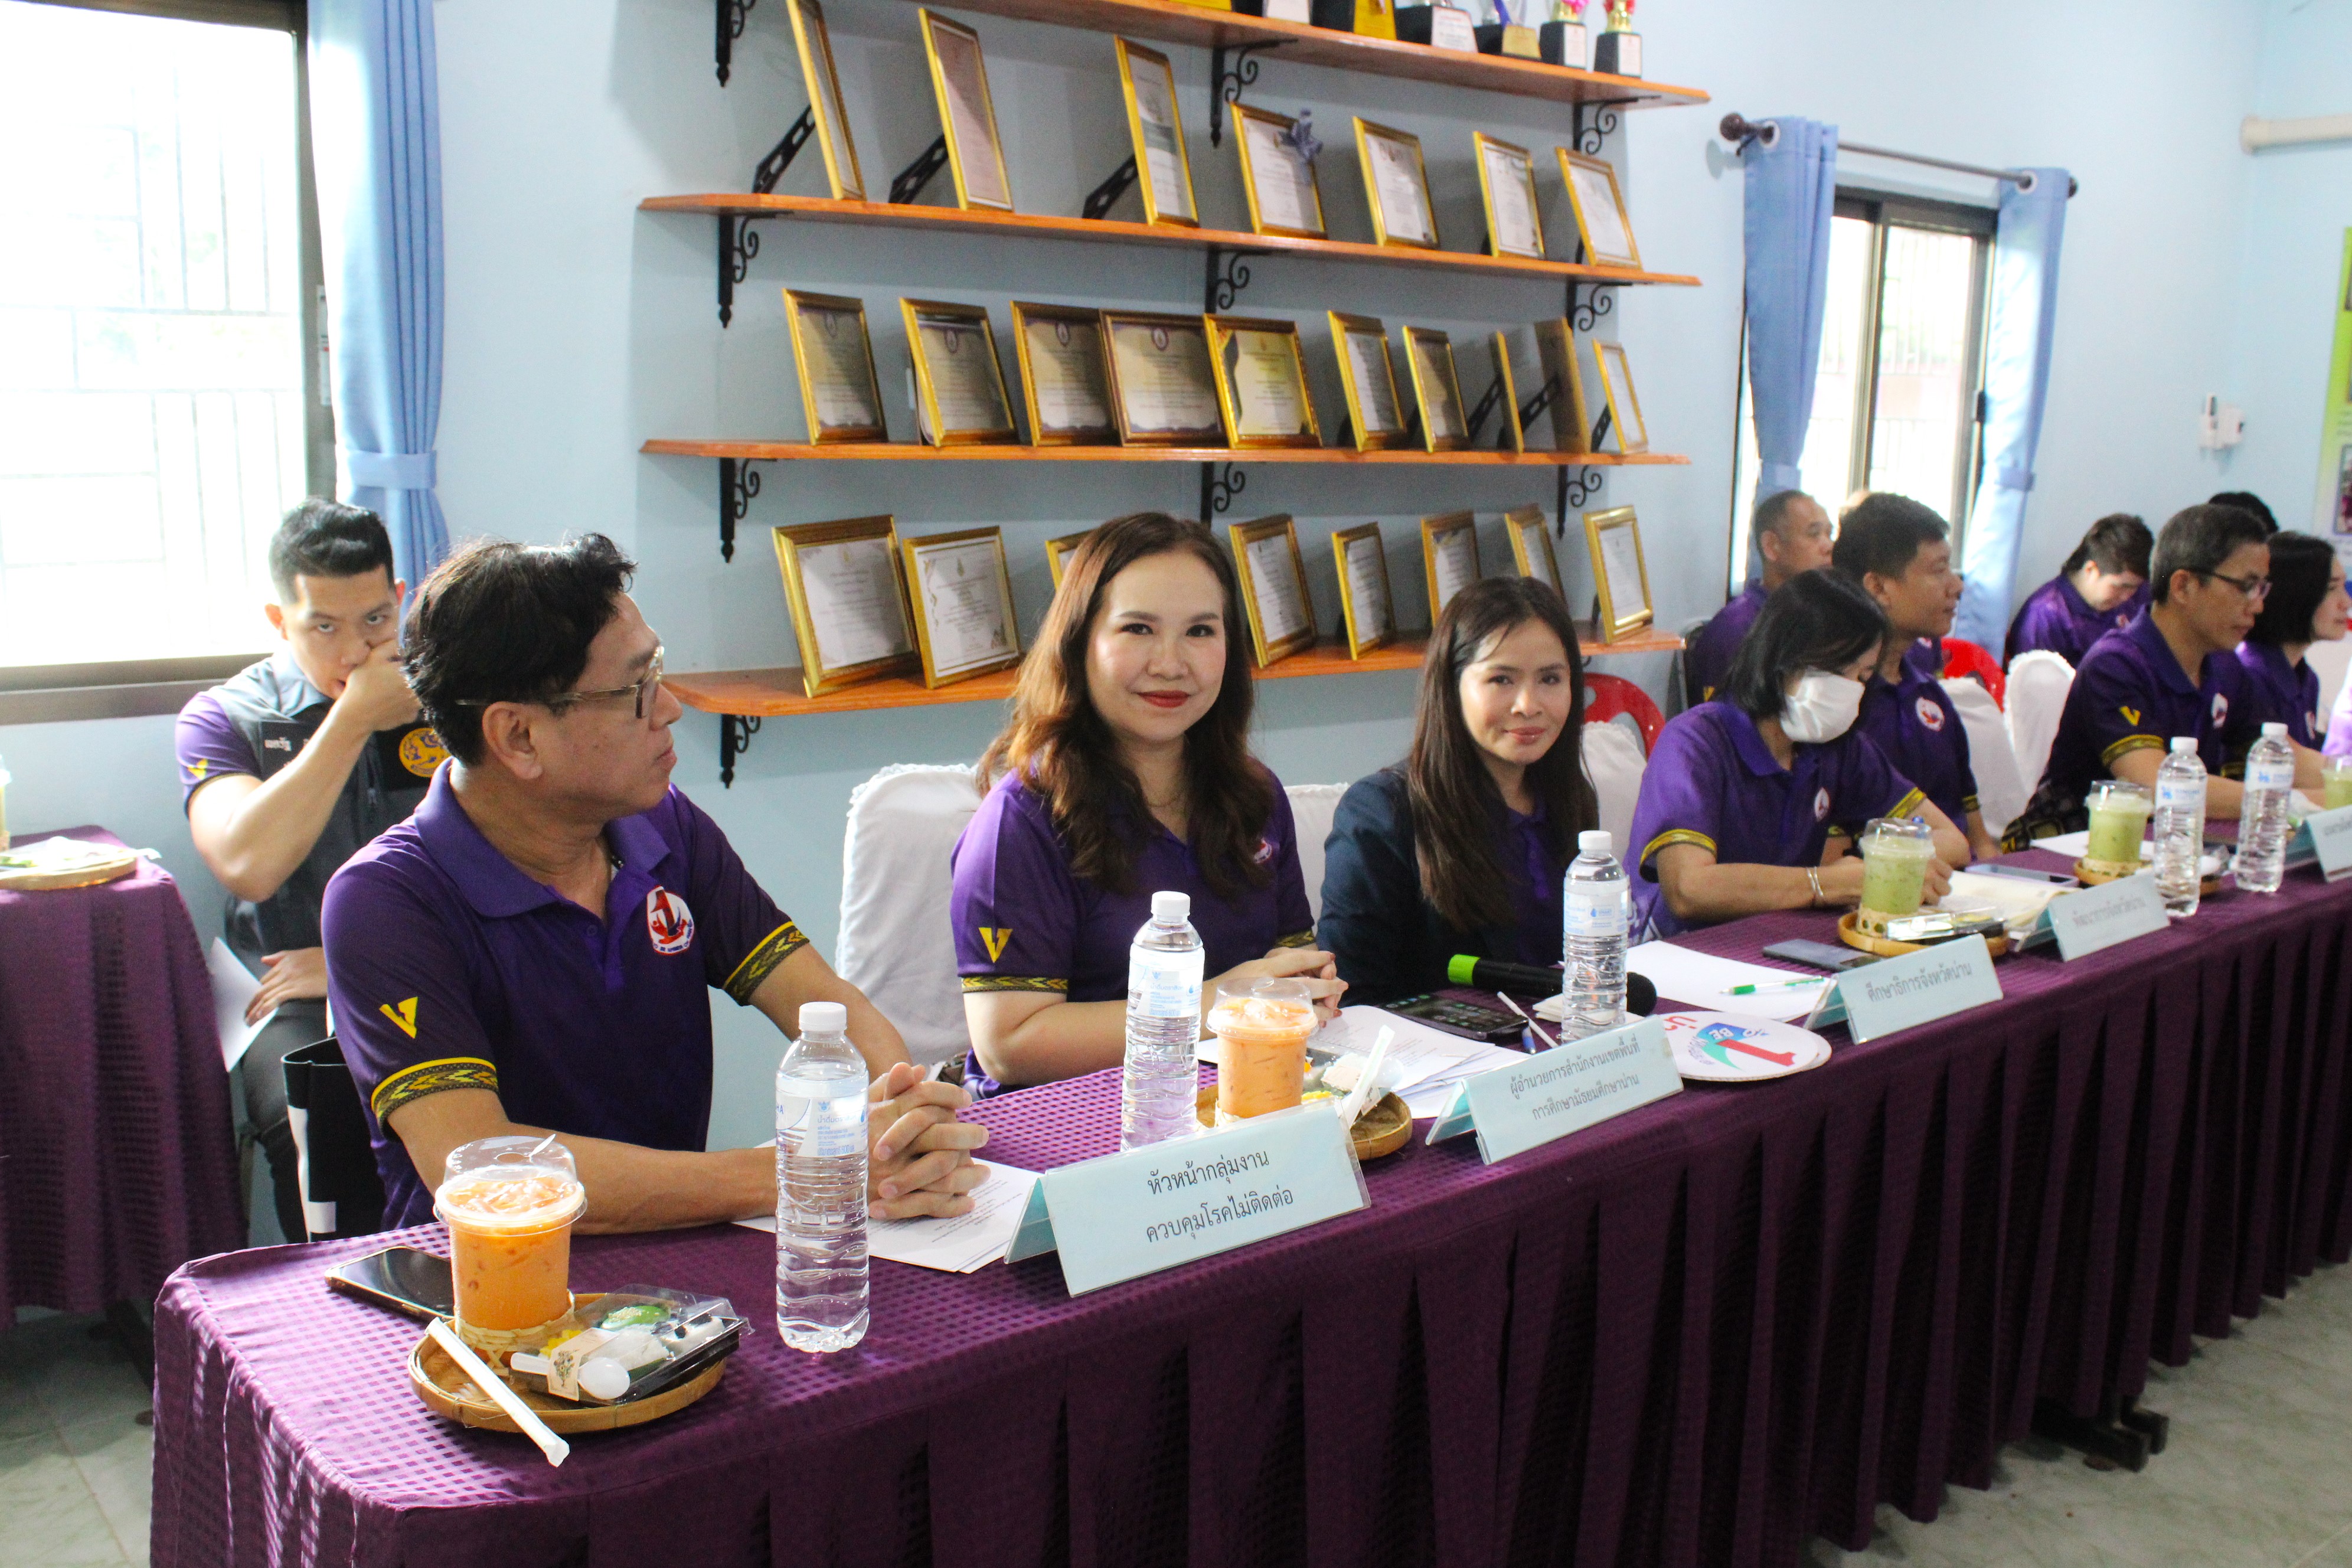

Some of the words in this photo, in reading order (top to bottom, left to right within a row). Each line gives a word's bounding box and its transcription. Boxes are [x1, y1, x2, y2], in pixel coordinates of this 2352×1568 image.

[1866, 960, 1972, 1002] ศึกษาธิการจังหวัดน่าน
[1709, 1027, 1734, 1040] BE
[1510, 1033, 1641, 1100] ผู้อำนวยการสำนักงานเขตพื้นที่
[1532, 1073, 1641, 1120] การศึกษามัธยมศึกษาน่าน
[1147, 1151, 1270, 1195] หัวหน้ากลุ่มงาน
[1146, 1184, 1293, 1243] ควบคุมโรคไม่ติดต่อ
